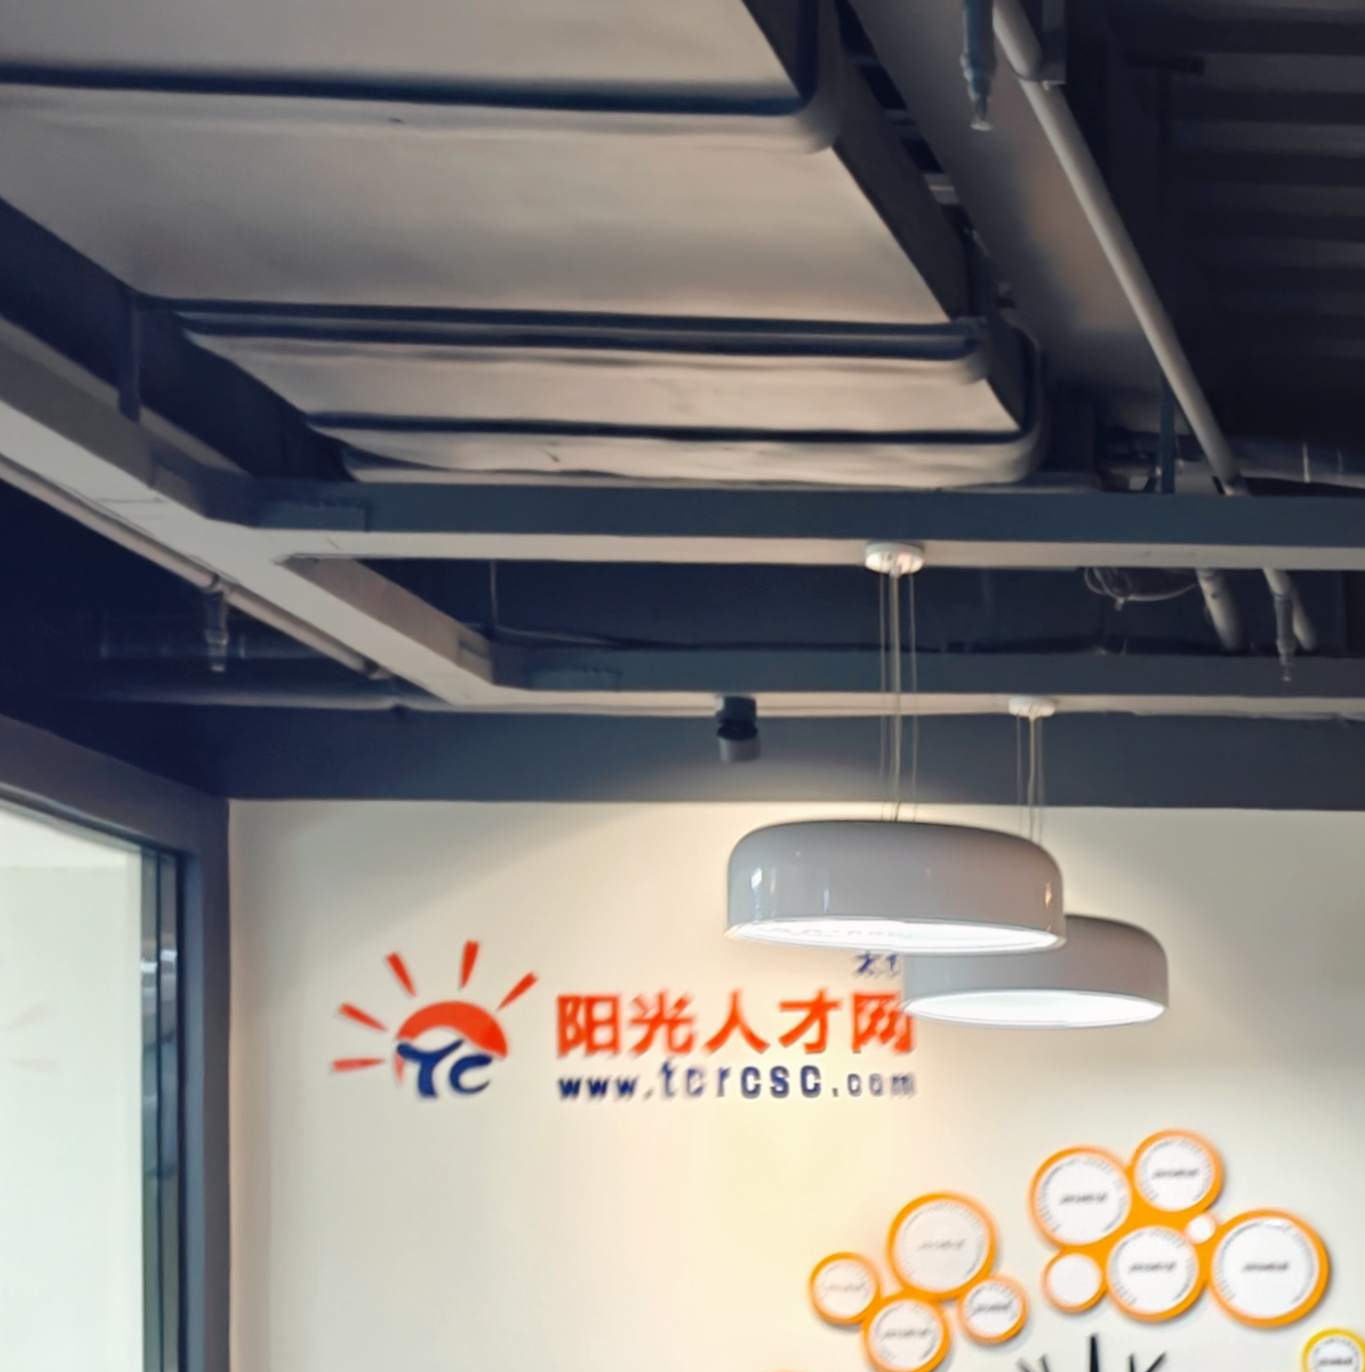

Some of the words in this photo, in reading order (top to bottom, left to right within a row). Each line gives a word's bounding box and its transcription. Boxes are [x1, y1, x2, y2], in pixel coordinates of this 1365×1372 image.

[555, 988, 917, 1058] 阳光人才网
[557, 1056, 916, 1101] www.tcrcsc.com
